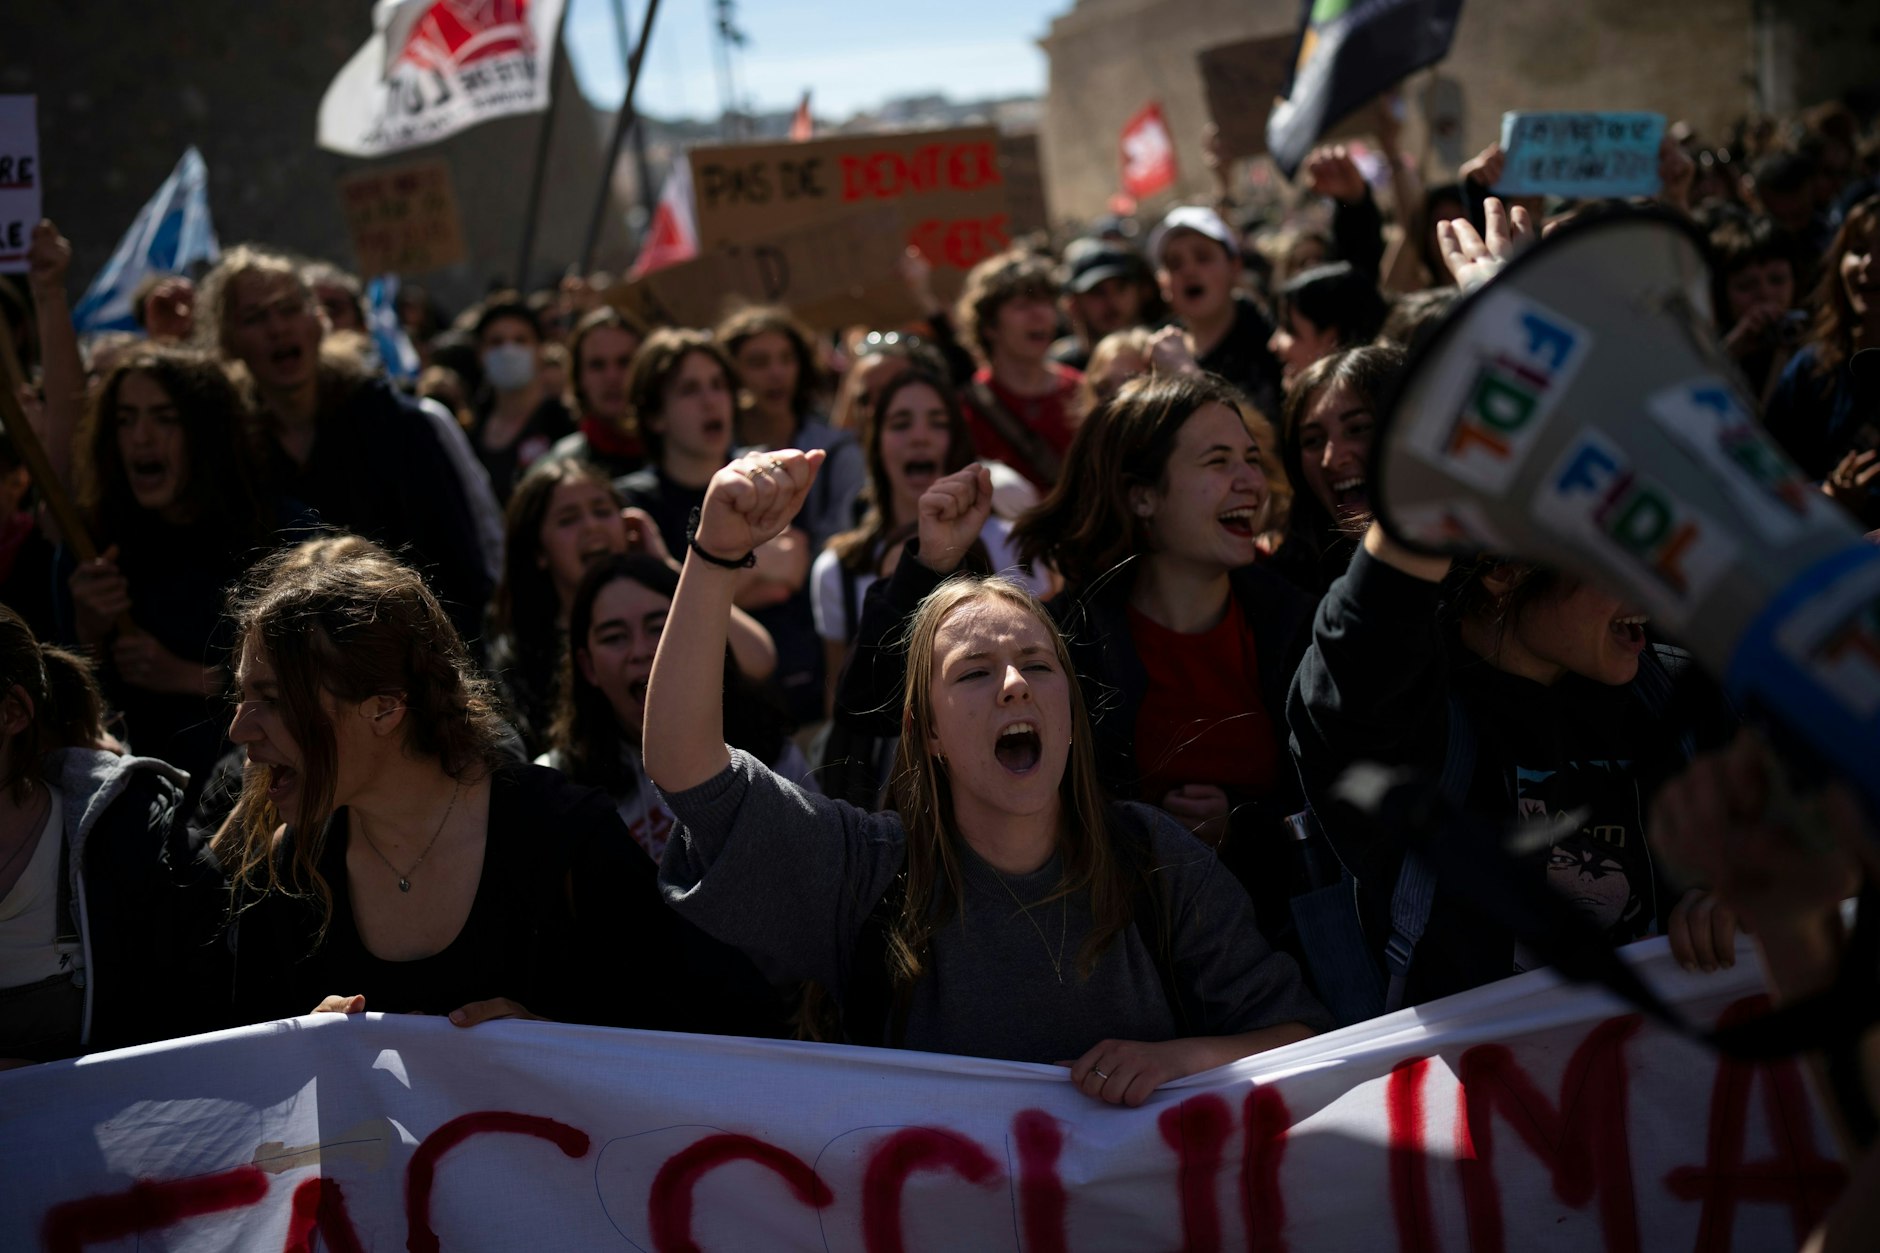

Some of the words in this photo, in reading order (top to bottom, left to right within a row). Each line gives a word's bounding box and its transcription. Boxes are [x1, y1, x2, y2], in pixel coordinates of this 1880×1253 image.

[703, 161, 773, 204] PAS
[780, 156, 825, 198] DE
[1451, 313, 1576, 459] FIDL
[1558, 444, 1699, 592] FIDL
